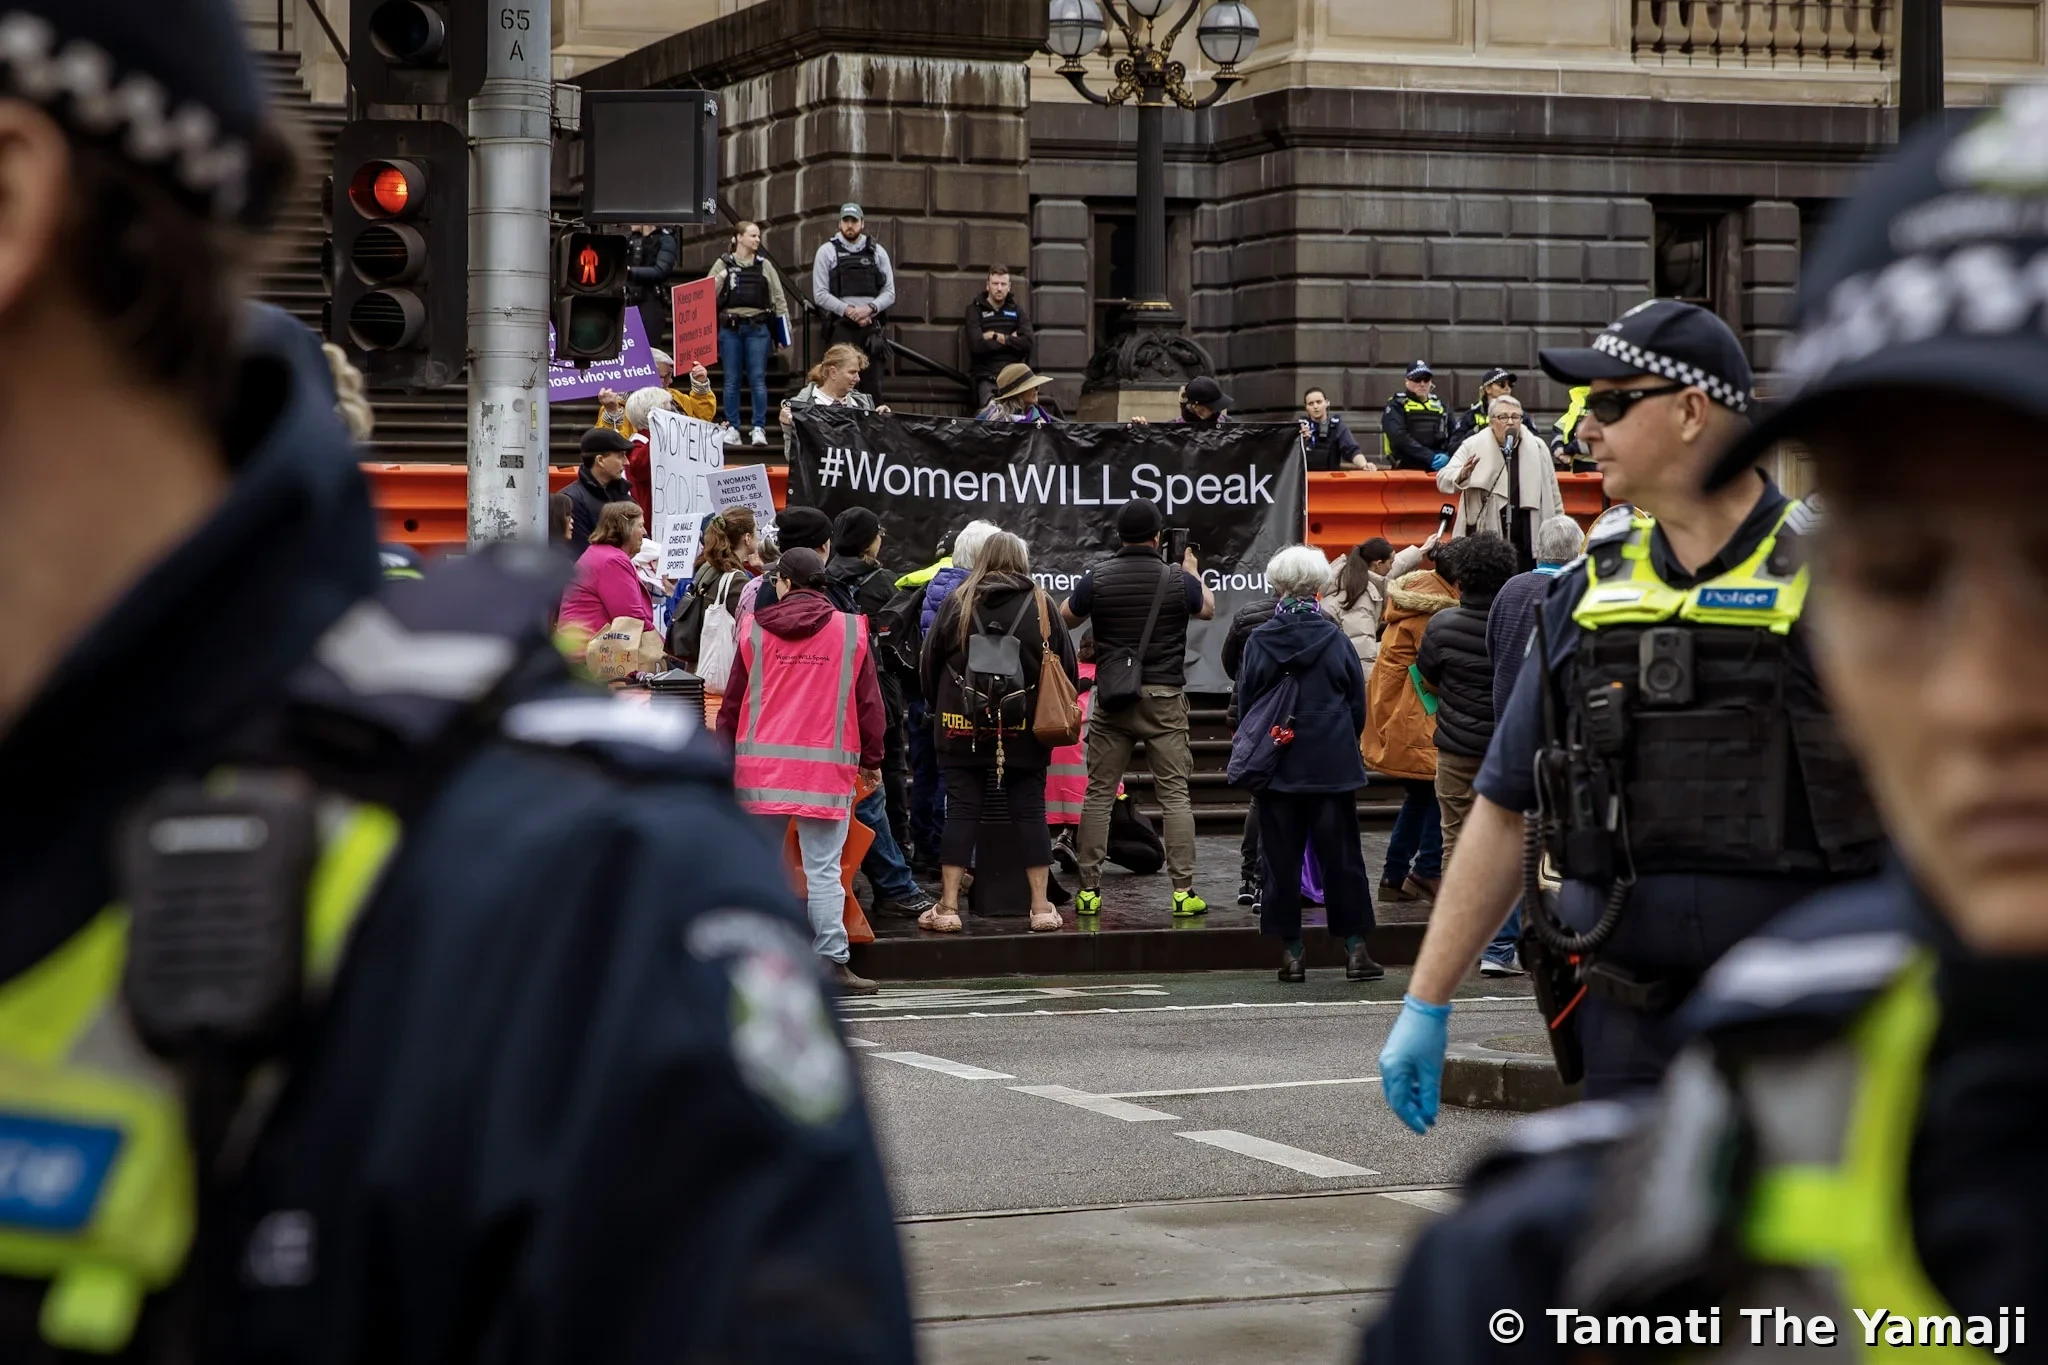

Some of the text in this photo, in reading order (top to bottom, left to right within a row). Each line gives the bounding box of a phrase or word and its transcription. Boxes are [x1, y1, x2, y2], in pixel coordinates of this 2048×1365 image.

[500, 8, 530, 31] 65
[509, 40, 524, 61] A
[678, 289, 704, 306] Keep men
[679, 309, 691, 325] OUT
[679, 321, 713, 344] women's and
[549, 363, 655, 388] hose who've tried.
[653, 414, 720, 468] WOMEN'S
[500, 455, 524, 468] 65
[506, 475, 516, 488] A
[717, 473, 757, 487] A WOMAN'S
[818, 446, 1275, 515] #WomenWILLSpeak
[654, 464, 706, 515] BODIE
[721, 483, 757, 495] NEED FOR
[720, 491, 763, 505] SINGLE- SEX
[673, 521, 693, 531] NO MALE
[669, 534, 692, 544] CHEATS IN
[668, 547, 688, 557] WOMEN'S
[666, 560, 684, 570] SPORTS
[1032, 569, 1091, 591] men'
[1705, 591, 1769, 605] Police
